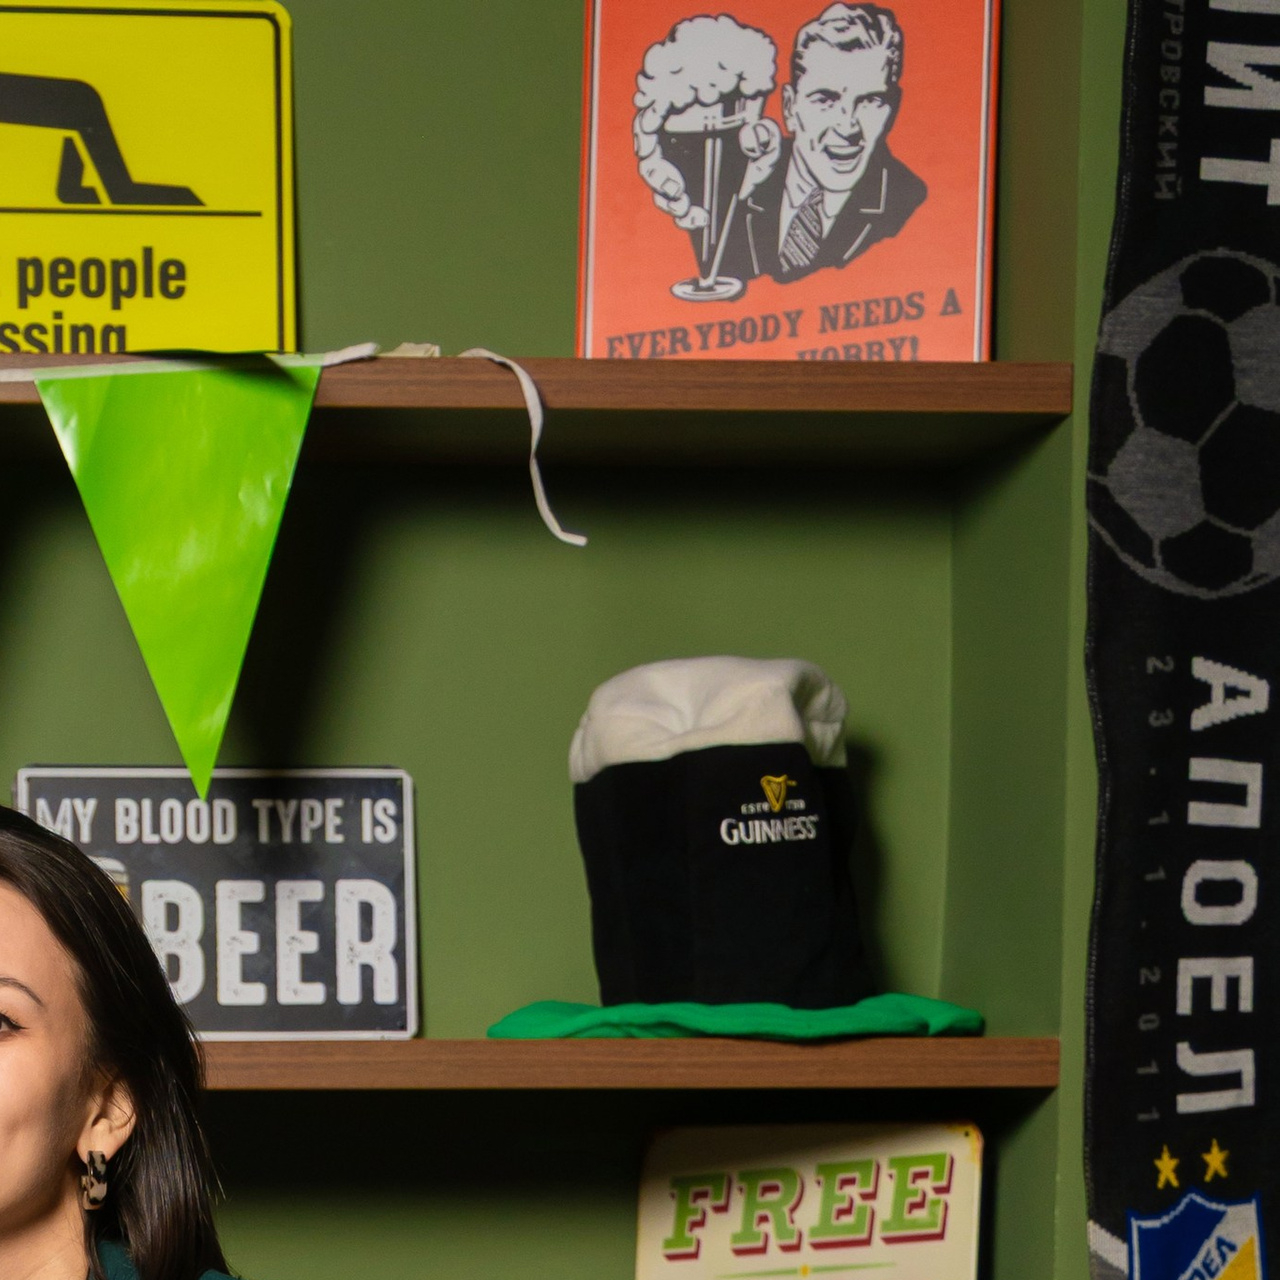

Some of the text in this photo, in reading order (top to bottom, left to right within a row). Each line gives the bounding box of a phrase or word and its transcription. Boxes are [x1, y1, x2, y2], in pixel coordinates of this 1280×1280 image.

[16, 245, 187, 310] people
[605, 287, 963, 360] EVERYBODY NEEDS A
[36, 797, 398, 845] MY BLOOD TYPE IS
[1175, 656, 1270, 1114] АПОЕЛ
[140, 878, 399, 1006] BEER
[662, 1152, 955, 1261] FREE
